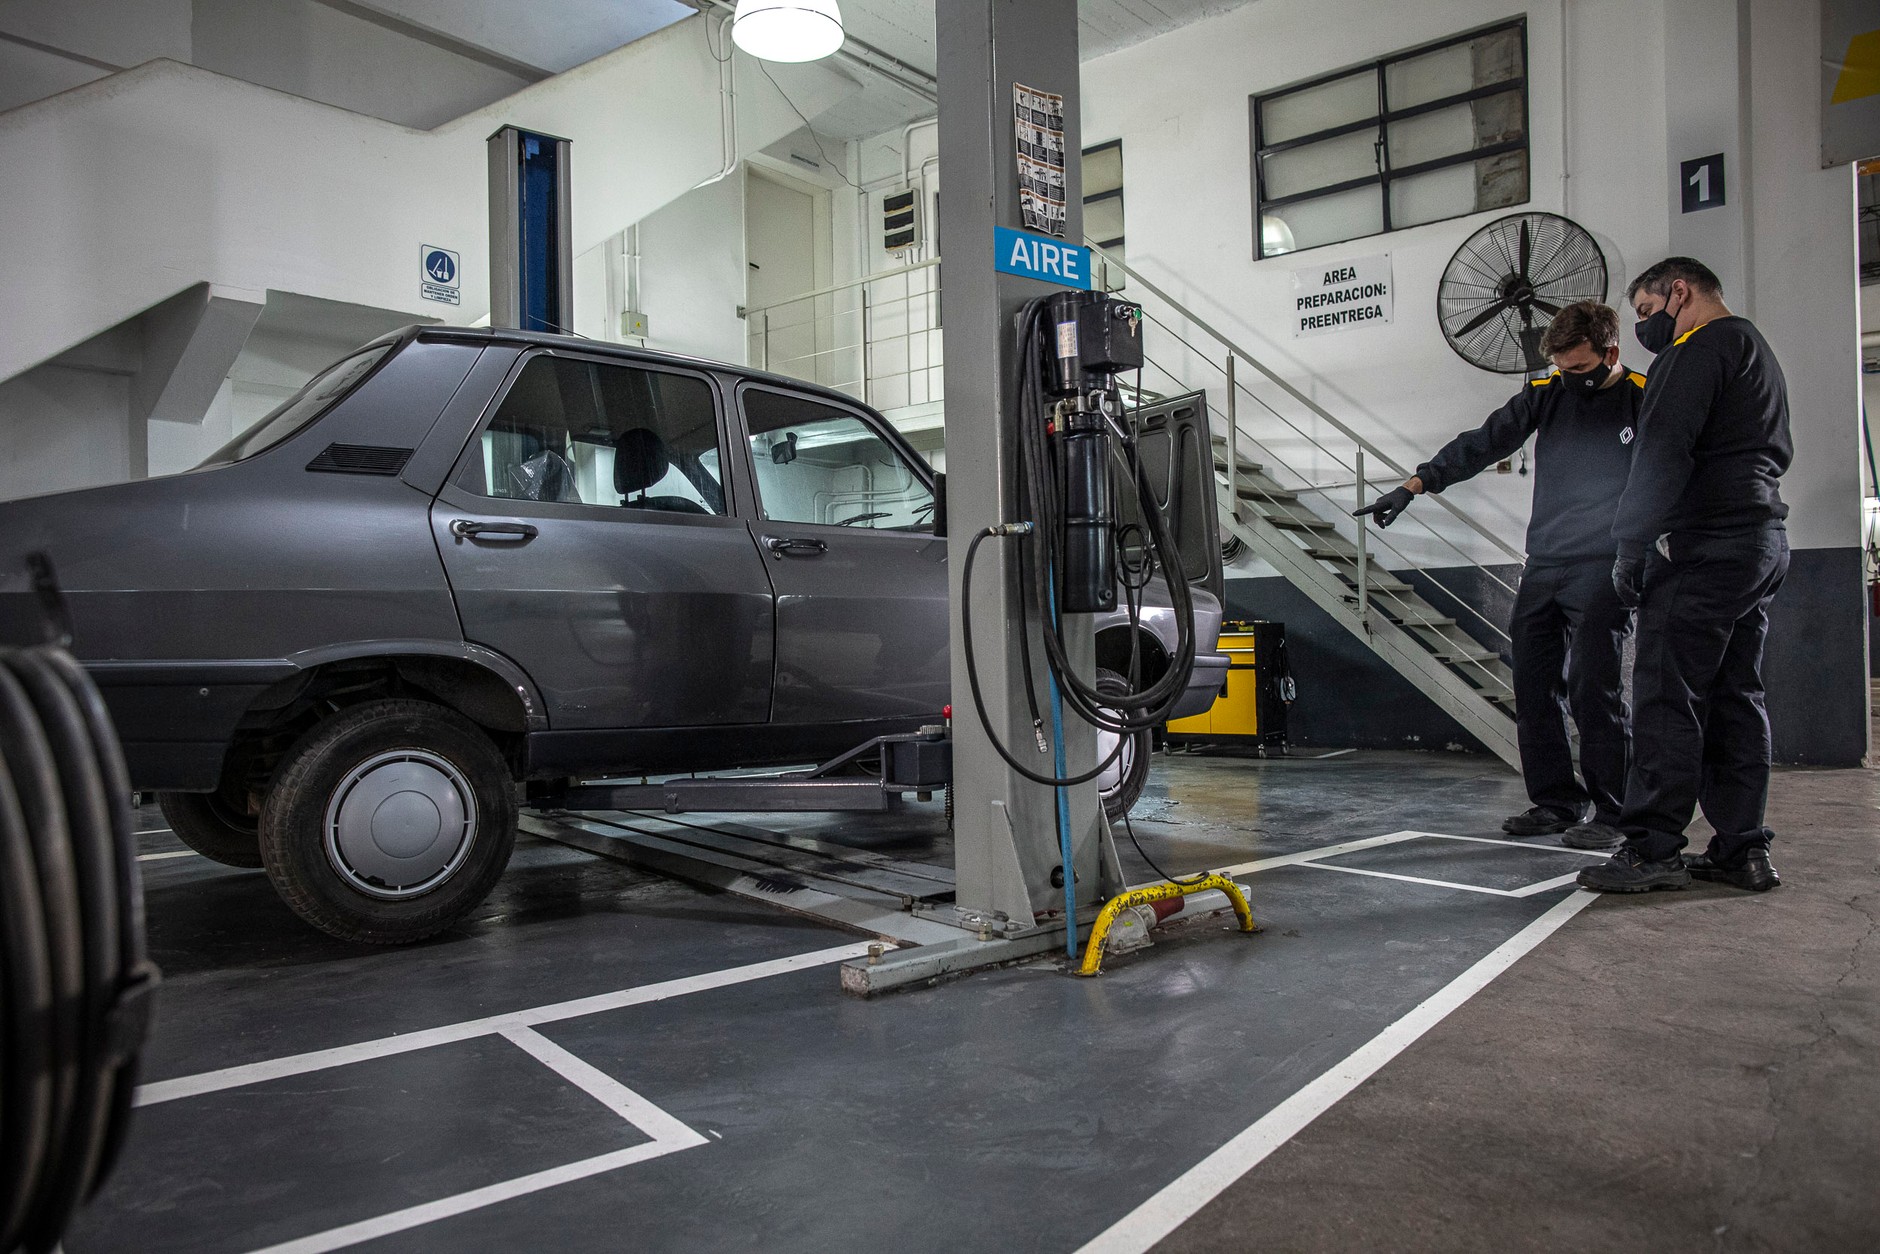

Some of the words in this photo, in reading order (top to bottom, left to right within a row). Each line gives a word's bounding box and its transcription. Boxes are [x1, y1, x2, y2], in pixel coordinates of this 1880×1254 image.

[1690, 164, 1709, 202] 1
[1010, 237, 1079, 280] AIRE
[1323, 267, 1356, 286] AREA
[1297, 283, 1386, 310] PREPARACION:
[1301, 305, 1383, 330] PREENTREGA
